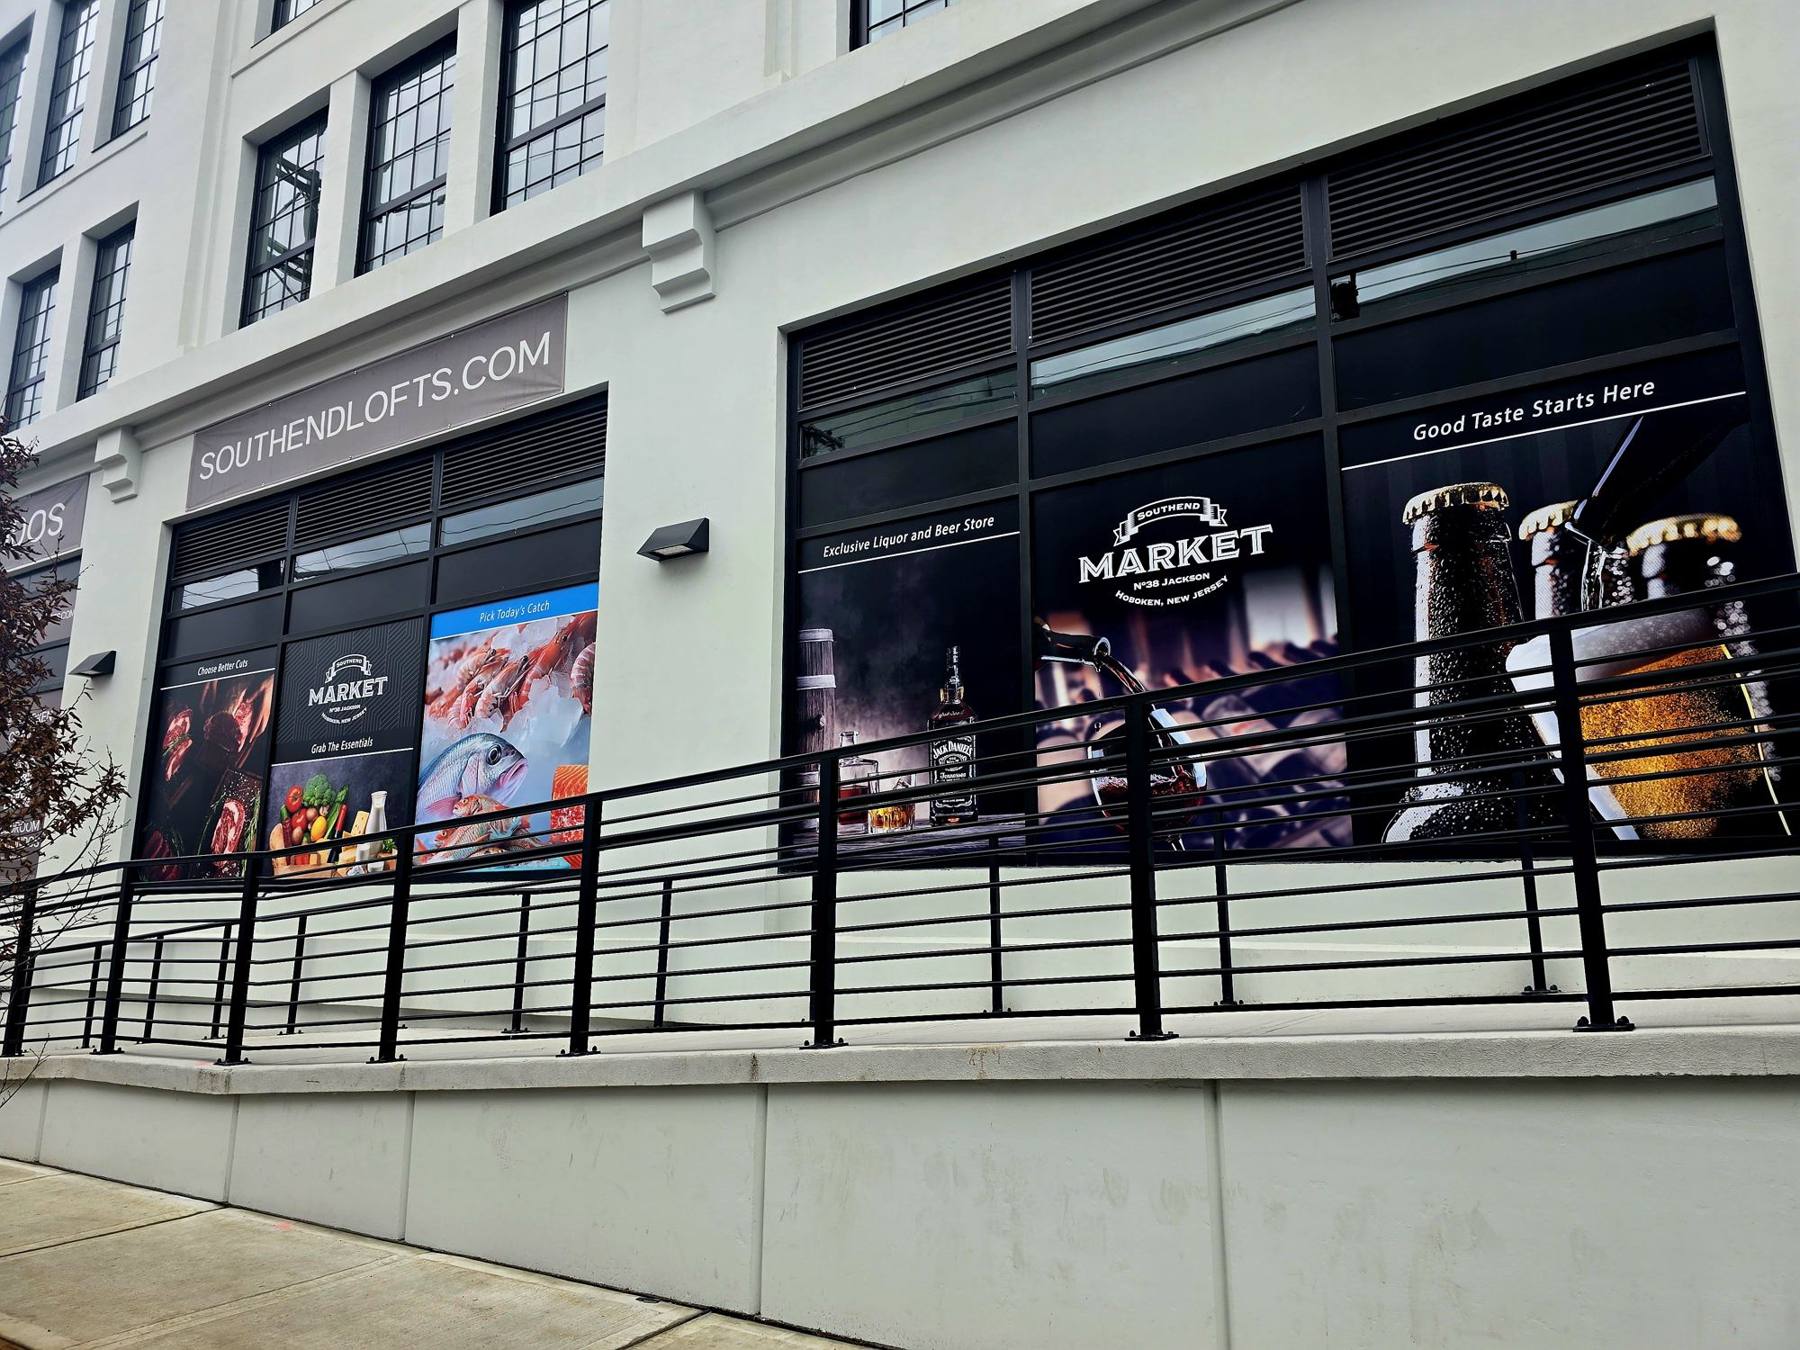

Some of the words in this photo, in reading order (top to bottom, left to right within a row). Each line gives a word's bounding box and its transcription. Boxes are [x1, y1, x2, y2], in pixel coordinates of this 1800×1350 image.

[199, 331, 551, 481] SOUTHENDLOFTS.COM
[1413, 414, 1465, 441] Good
[1472, 405, 1524, 430] Taste
[1532, 392, 1594, 418] Starts
[1603, 381, 1655, 404] Here
[1136, 502, 1201, 521] SOUTHEND
[823, 539, 871, 558] Exclusive
[873, 533, 909, 549] Liquor
[911, 526, 932, 541] and
[935, 522, 961, 537] Beer
[963, 516, 995, 532] Store
[1078, 523, 1274, 584] MARKET
[1161, 572, 1211, 587] JACKSON
[1166, 594, 1190, 605] NEW
[1192, 575, 1229, 600] JERSEY
[480, 610, 495, 623] Pick
[497, 604, 525, 619] Today's
[527, 600, 550, 614] Catch
[197, 666, 218, 676] Choose
[218, 662, 236, 673] Better
[235, 659, 249, 669] Cuts
[308, 676, 388, 707] MARKET
[311, 743, 327, 754] Grab
[328, 740, 339, 752] The
[341, 737, 373, 751] Essentials
[932, 744, 949, 760] JACK
